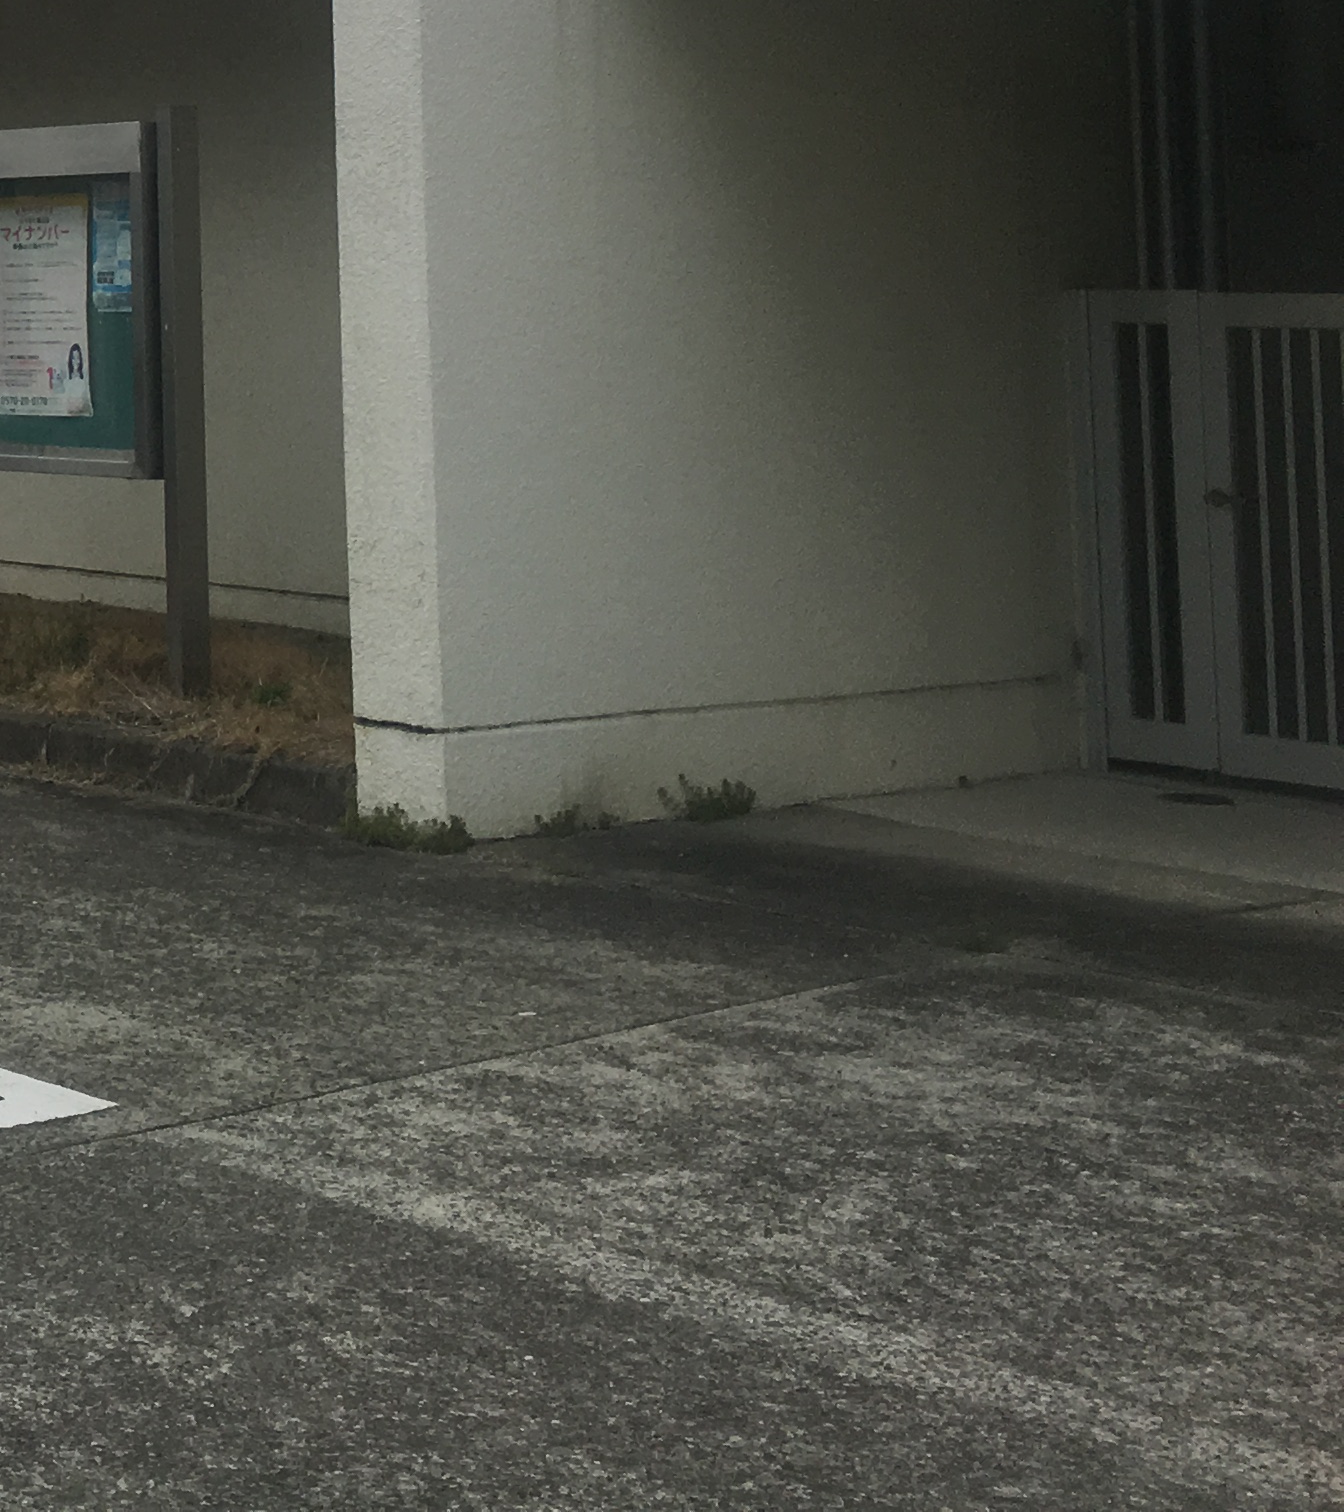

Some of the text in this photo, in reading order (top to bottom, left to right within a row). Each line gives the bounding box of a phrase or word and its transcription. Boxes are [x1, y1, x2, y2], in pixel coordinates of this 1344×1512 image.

[0, 224, 70, 242] マイナンバー
